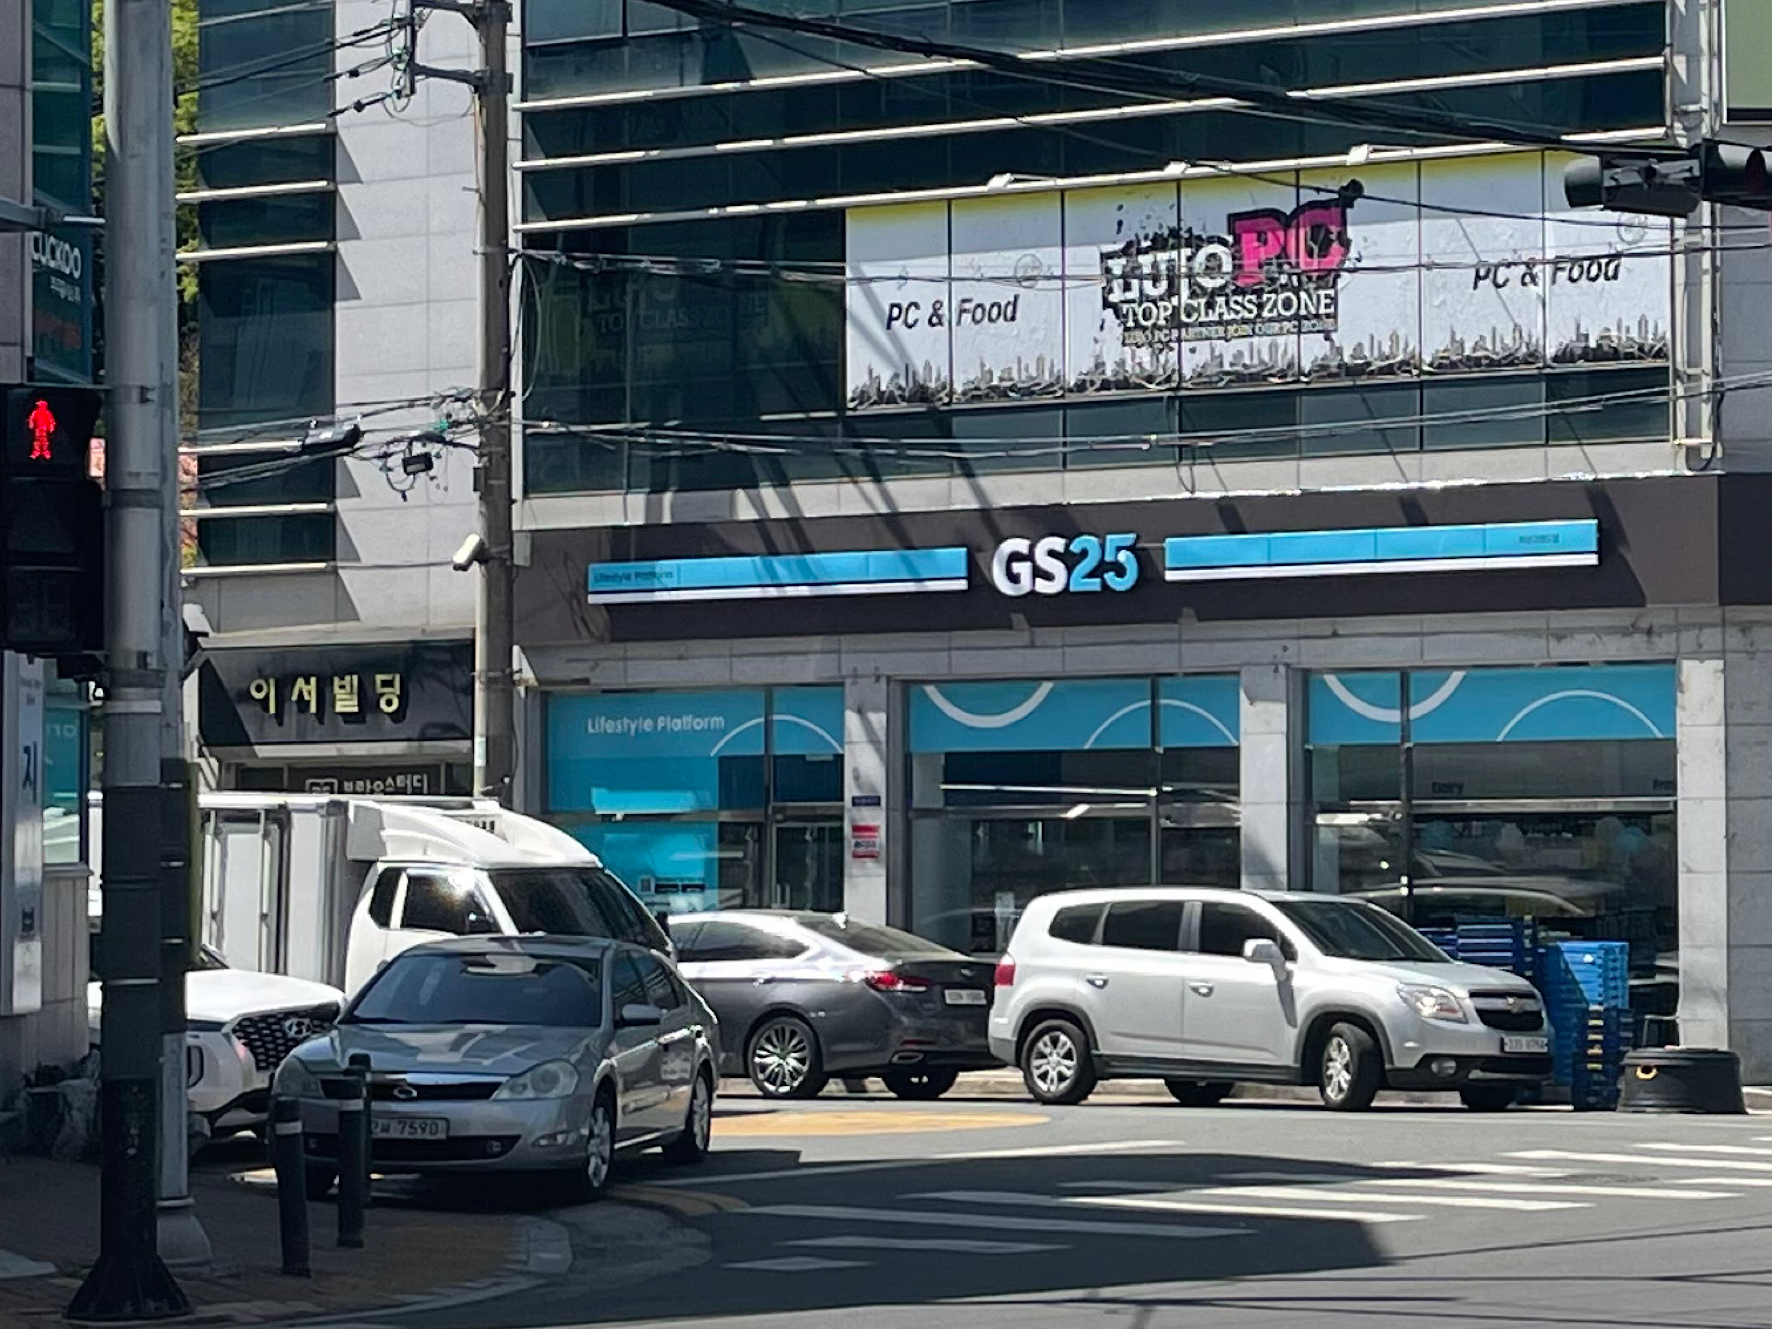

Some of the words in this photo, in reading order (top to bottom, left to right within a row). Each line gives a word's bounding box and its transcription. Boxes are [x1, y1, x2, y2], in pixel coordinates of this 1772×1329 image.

[1106, 243, 1233, 302] LUJO
[1234, 208, 1346, 287] PC
[1473, 260, 1510, 291] PC
[887, 301, 919, 330] PC
[928, 302, 947, 328] &
[956, 293, 1020, 327] Food
[1121, 302, 1174, 327] TOP
[1180, 295, 1259, 322] CLASS
[1262, 288, 1335, 317] ZONE
[991, 532, 1138, 597] GS25
[249, 673, 401, 714] 이서빌딩
[587, 715, 653, 738] Lifestyle
[656, 714, 725, 733] Platform
[398, 1119, 439, 1136] 7590
